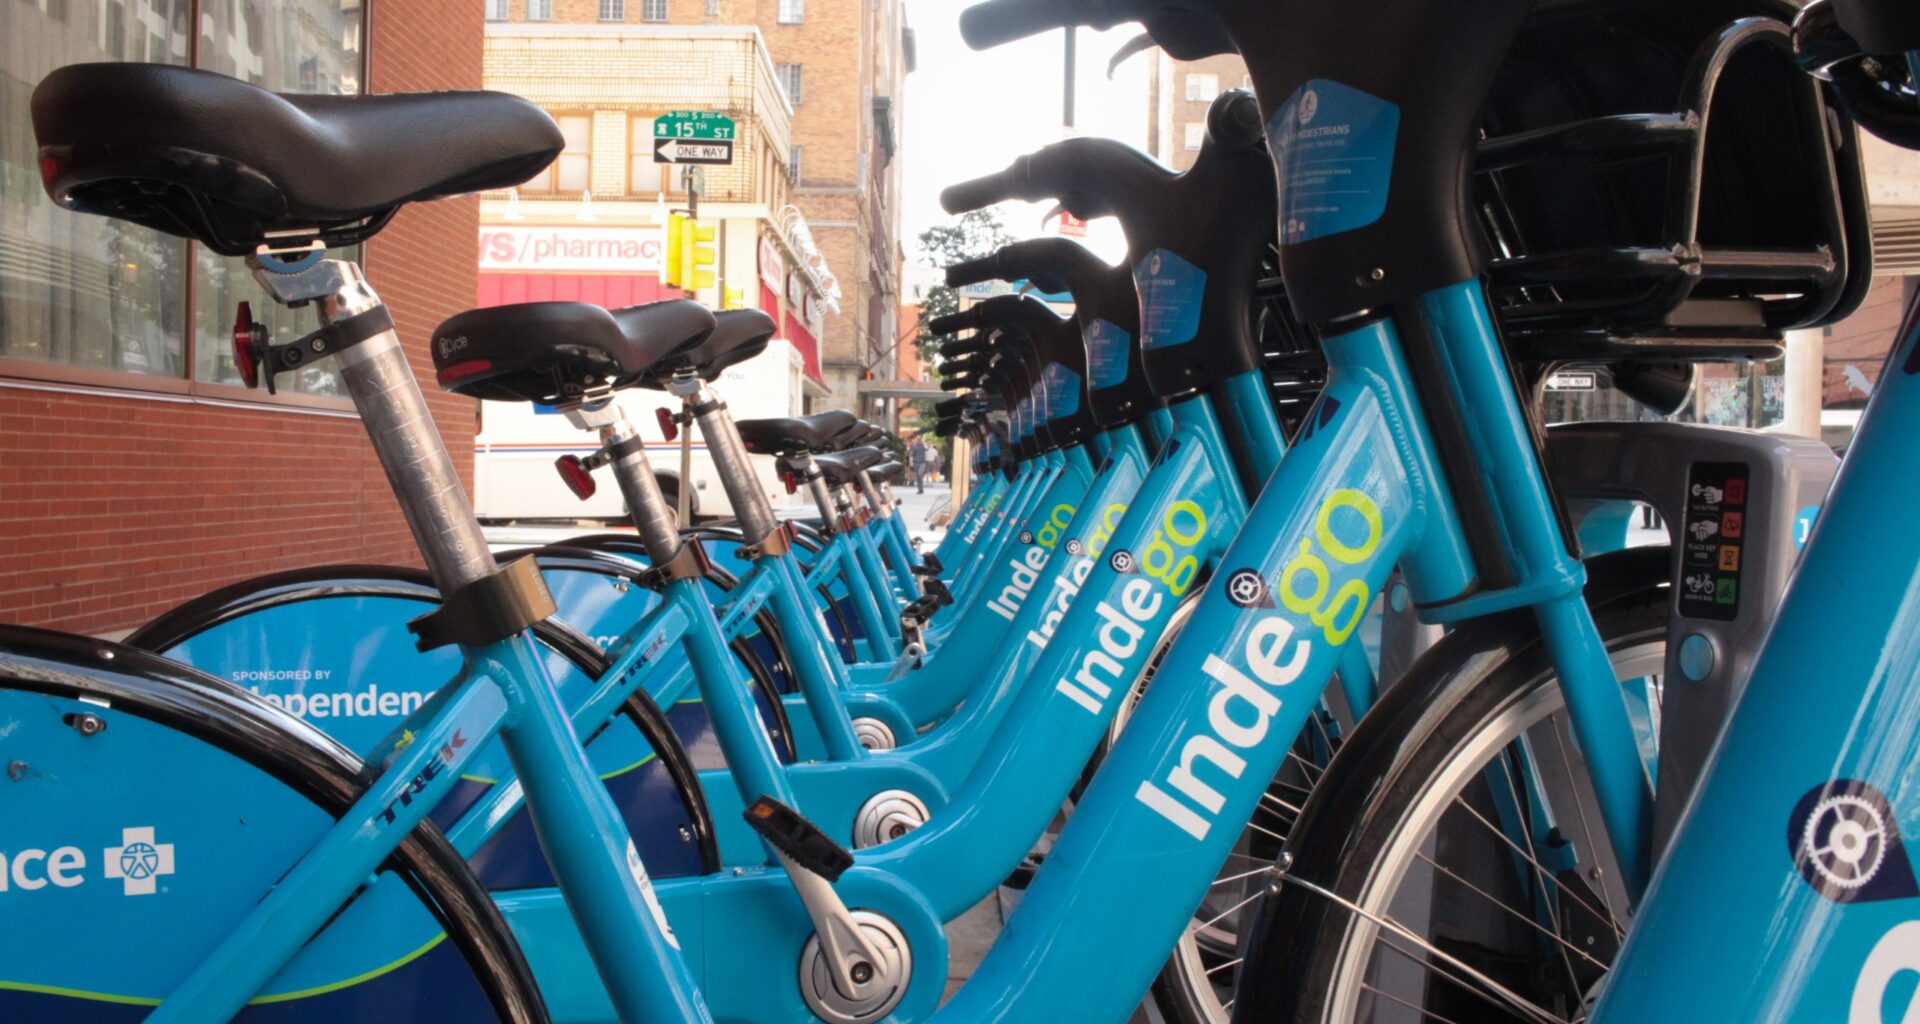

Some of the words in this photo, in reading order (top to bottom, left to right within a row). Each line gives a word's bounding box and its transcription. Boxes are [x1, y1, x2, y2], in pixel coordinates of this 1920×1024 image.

[677, 147, 698, 157] ONE
[703, 148, 724, 157] WAY
[714, 128, 730, 138] ST
[1056, 500, 1207, 716] Indego
[232, 670, 311, 681] SPONSORED
[315, 670, 331, 680] BY
[1135, 489, 1383, 842] Indego
[375, 727, 468, 825] TREK
